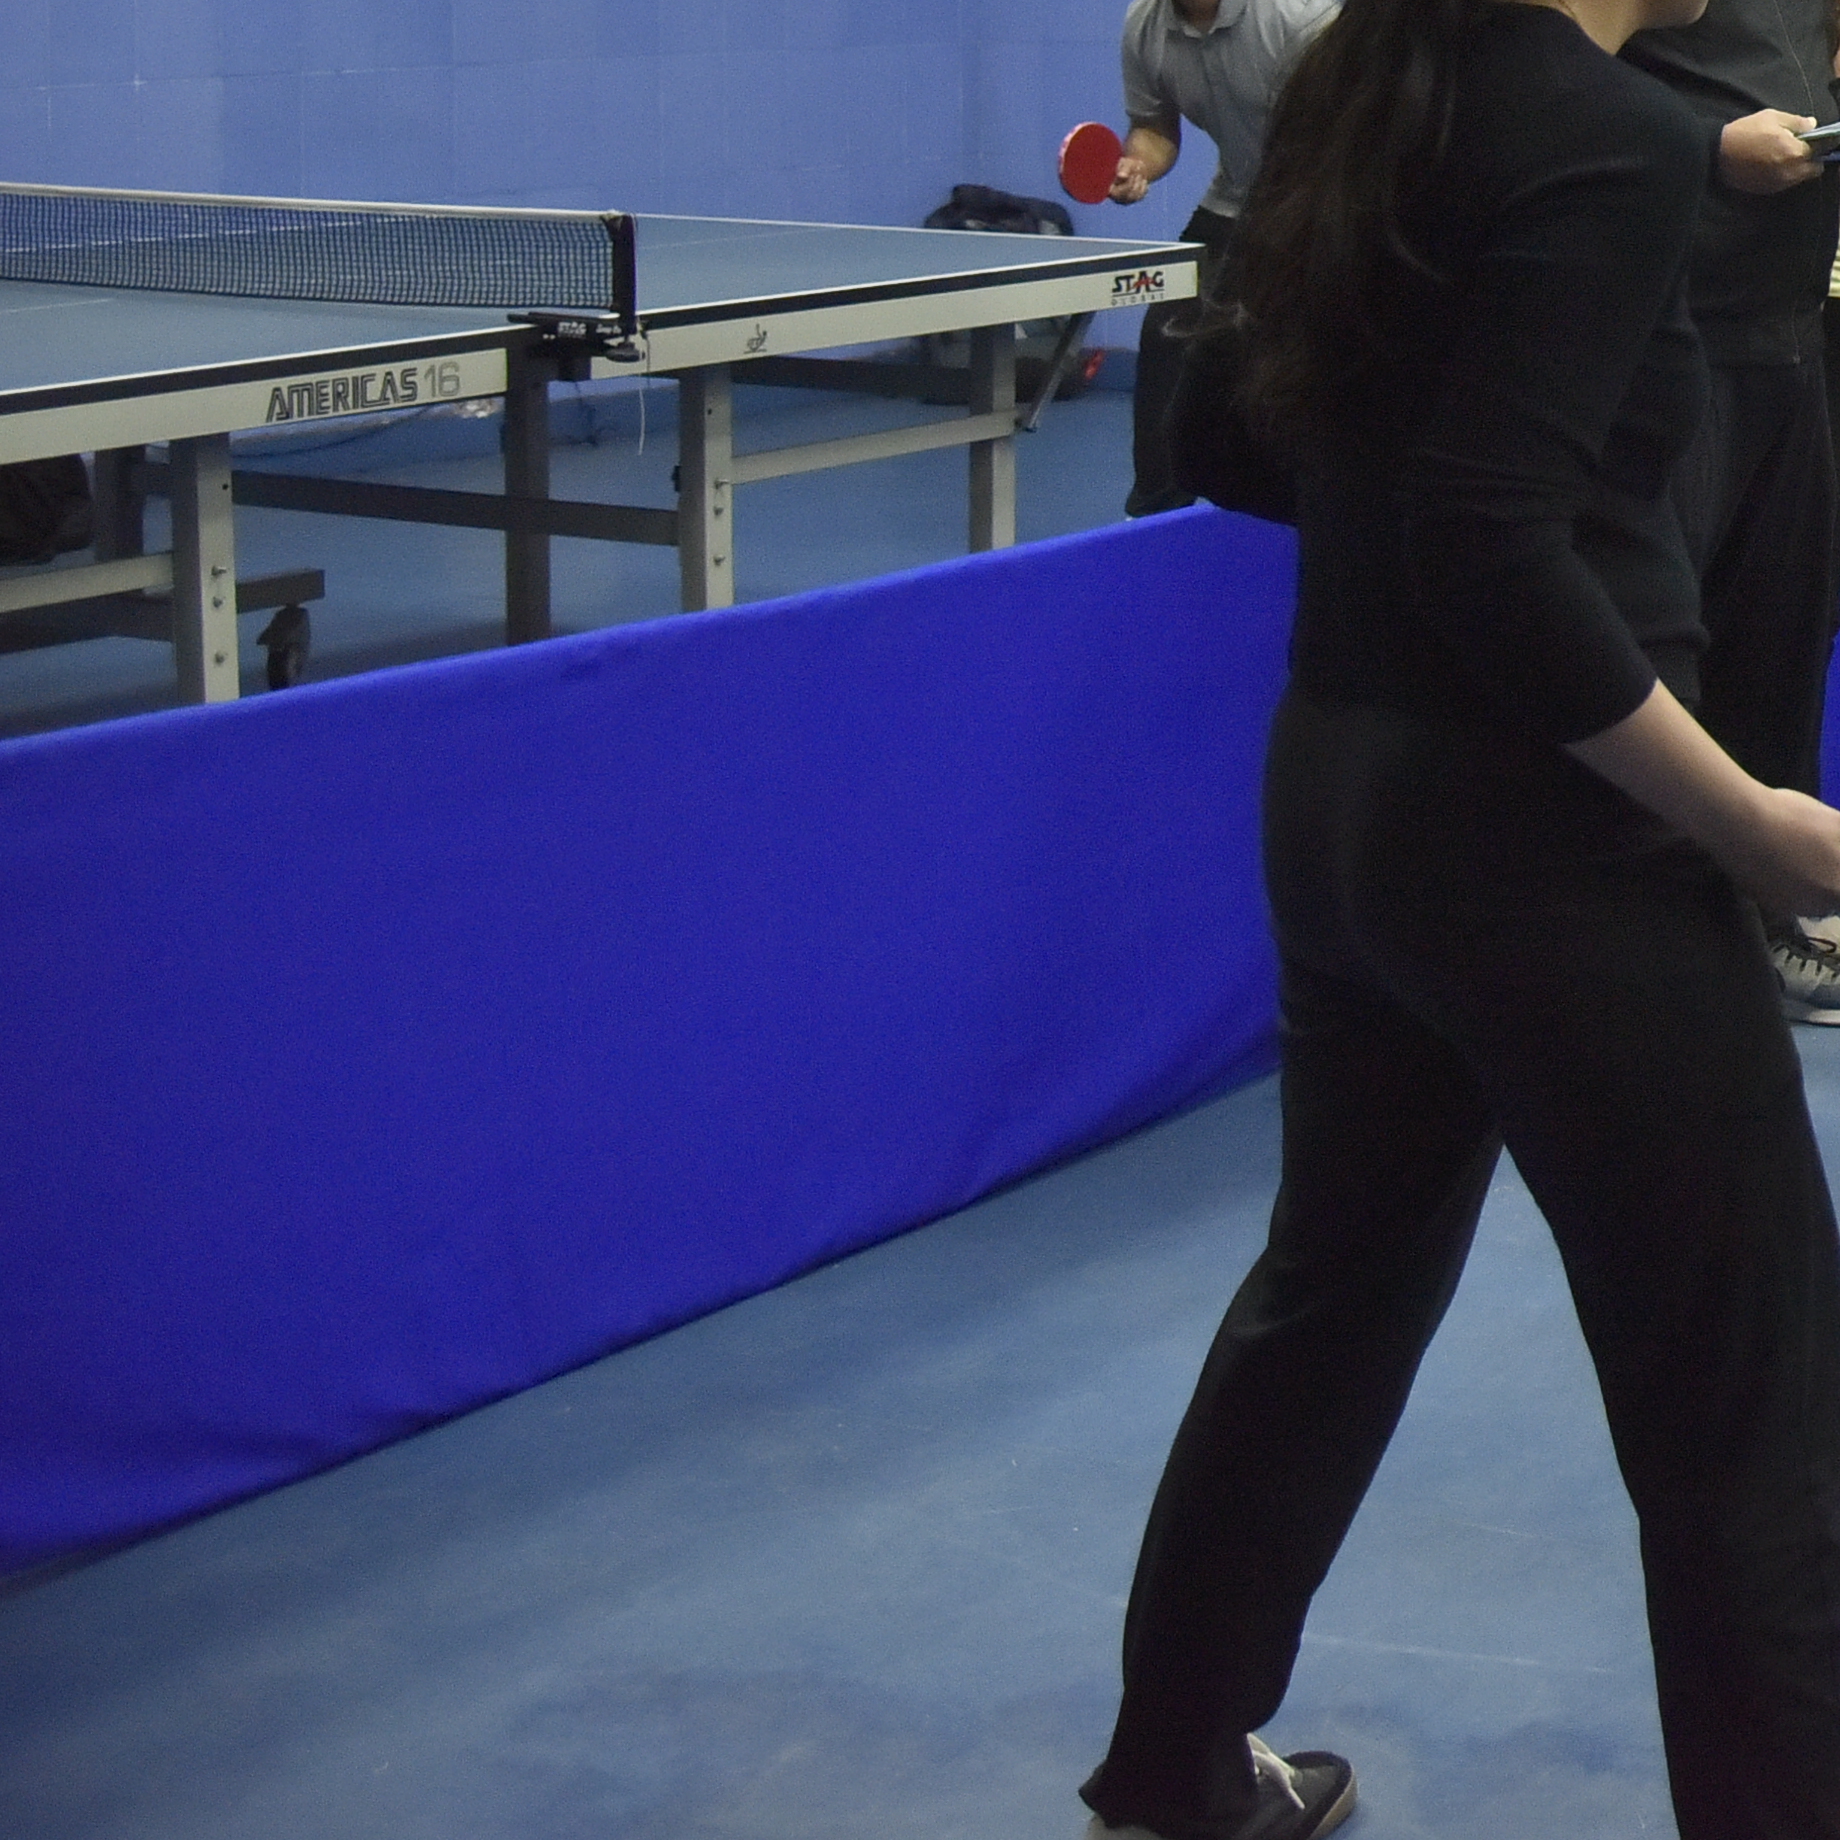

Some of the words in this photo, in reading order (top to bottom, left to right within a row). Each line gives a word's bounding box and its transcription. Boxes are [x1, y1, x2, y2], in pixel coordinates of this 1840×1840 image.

[1112, 271, 1165, 293] STAG
[266, 367, 418, 423] AMERICAS
[424, 361, 461, 398] 16
